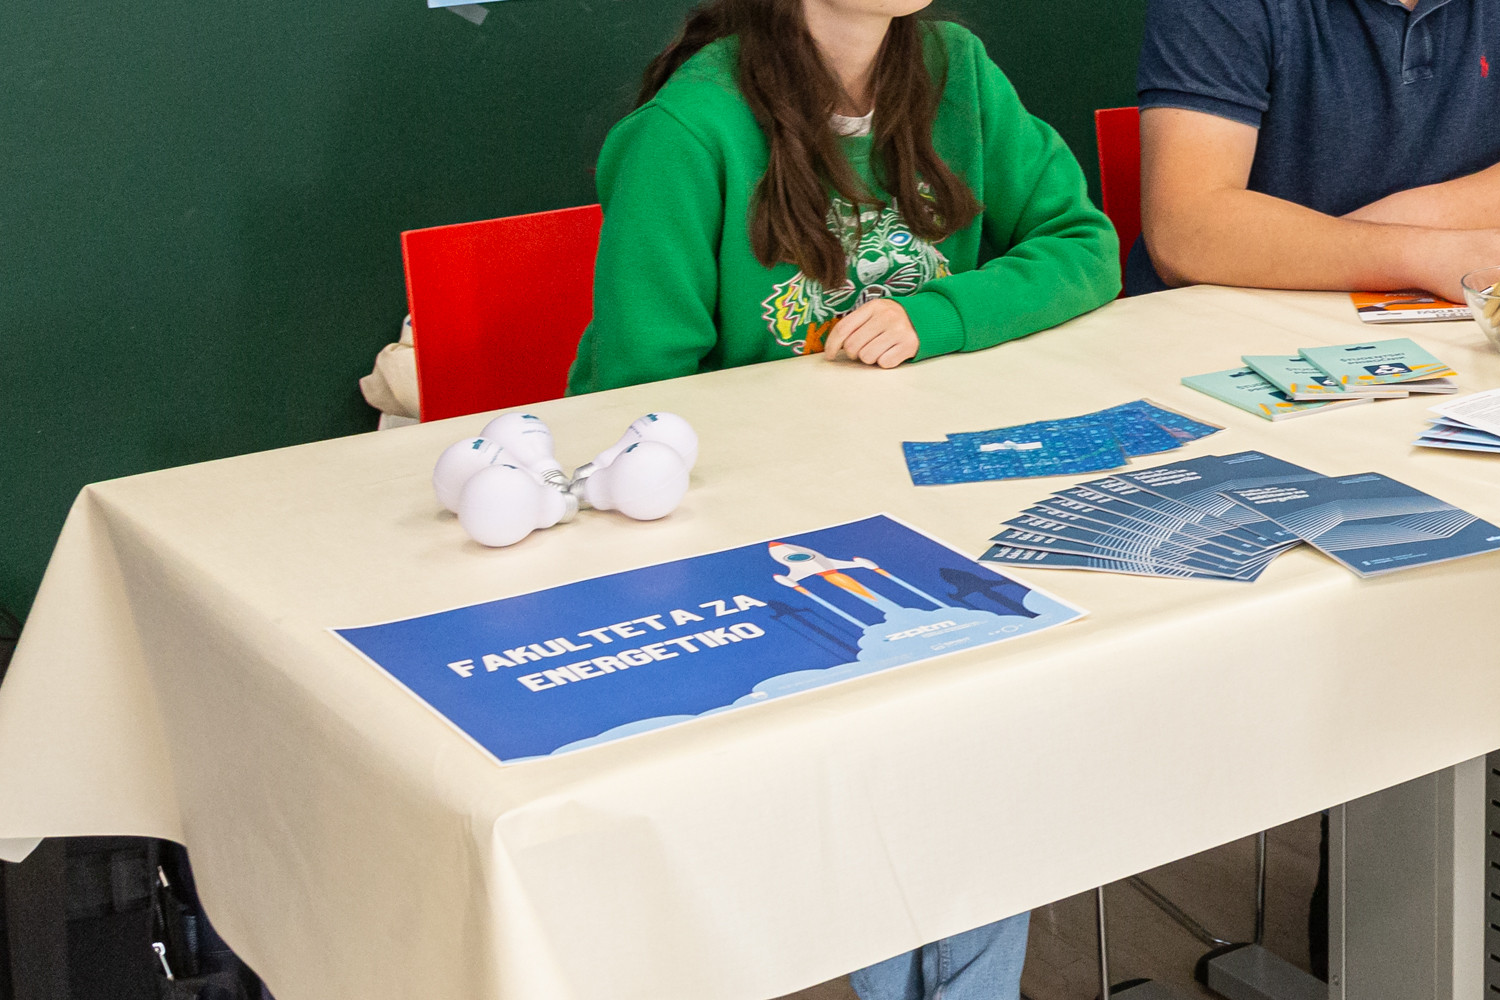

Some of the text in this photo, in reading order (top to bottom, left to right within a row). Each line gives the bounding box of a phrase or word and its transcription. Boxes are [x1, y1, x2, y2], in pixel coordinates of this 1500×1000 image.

[447, 594, 768, 679] FAKULTETA ZA
[517, 622, 766, 692] ENERGETIKO
